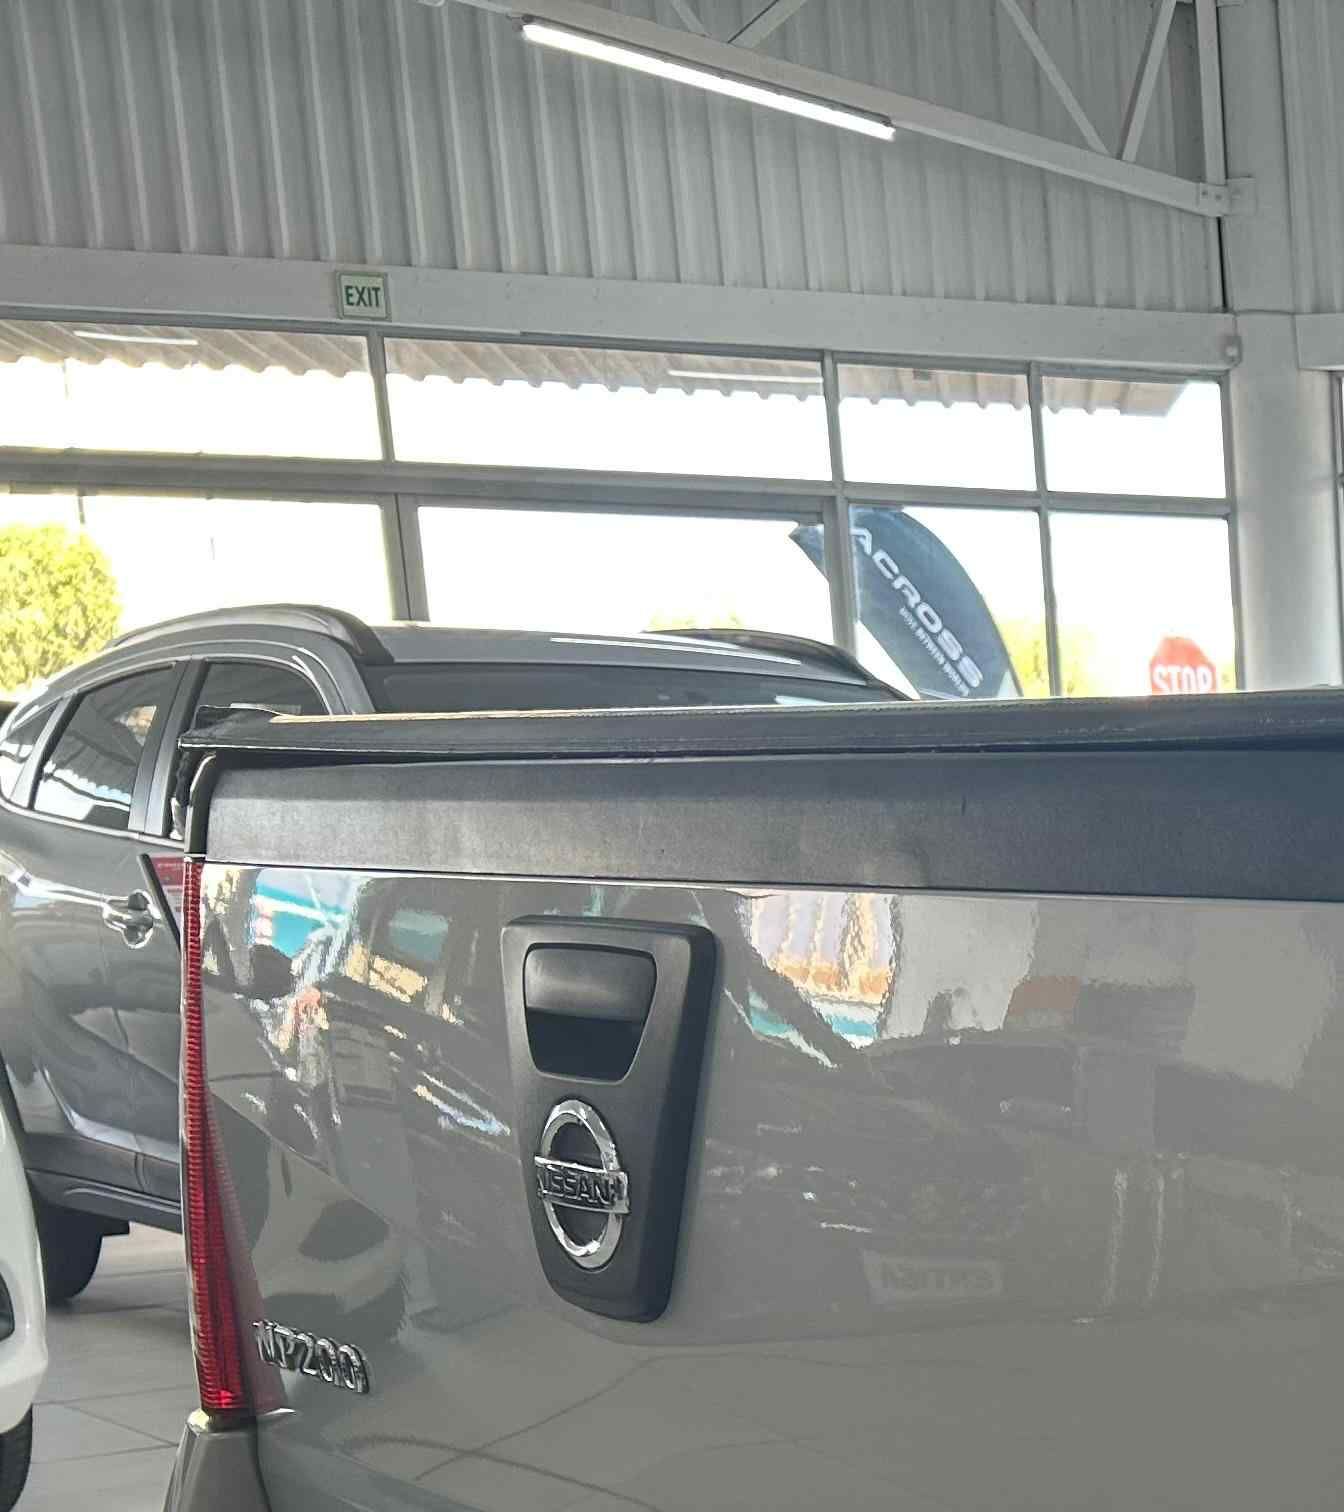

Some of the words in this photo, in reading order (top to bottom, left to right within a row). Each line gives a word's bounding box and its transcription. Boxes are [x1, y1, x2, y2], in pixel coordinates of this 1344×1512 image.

[344, 285, 381, 307] EXIT
[851, 527, 984, 688] ACROSS
[1152, 664, 1213, 695] STOP
[537, 1163, 617, 1206] NISSAN
[252, 1319, 369, 1393] NP200
